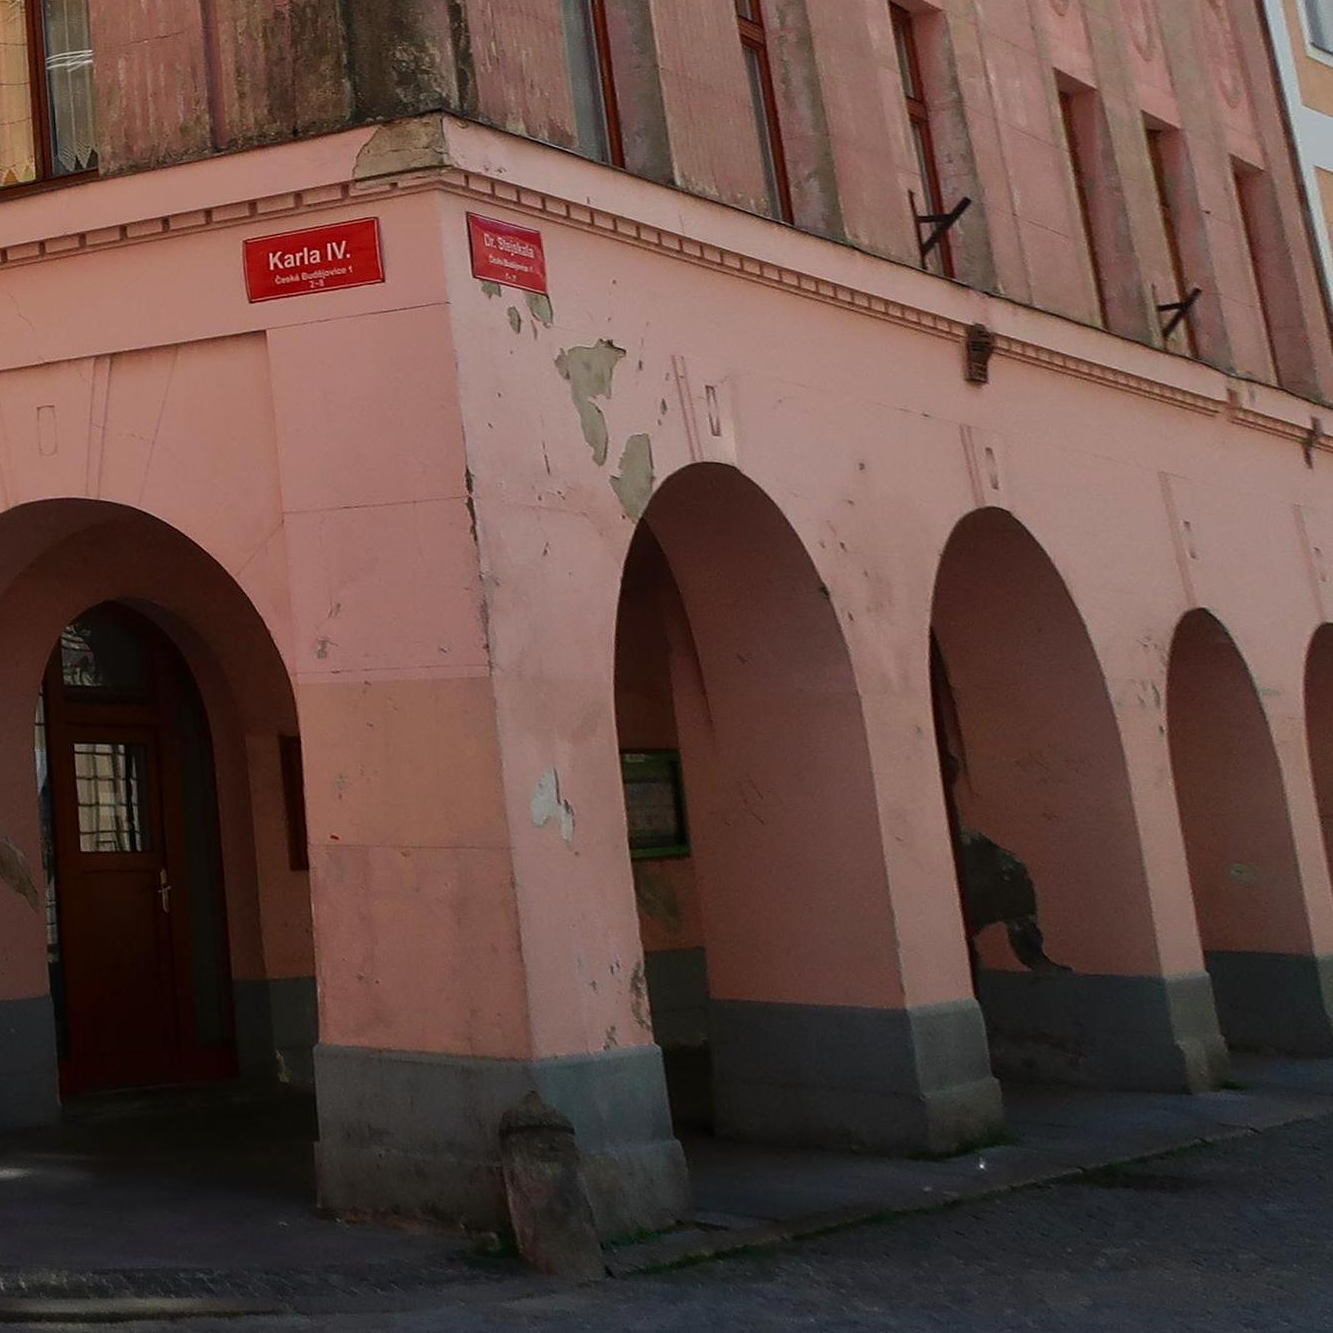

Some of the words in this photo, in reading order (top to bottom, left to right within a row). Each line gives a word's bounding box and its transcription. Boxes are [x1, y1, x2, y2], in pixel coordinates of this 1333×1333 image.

[484, 233, 497, 248] Dr.
[269, 246, 321, 270] Karla
[326, 240, 351, 262] IV.
[301, 267, 346, 282] Budějovice
